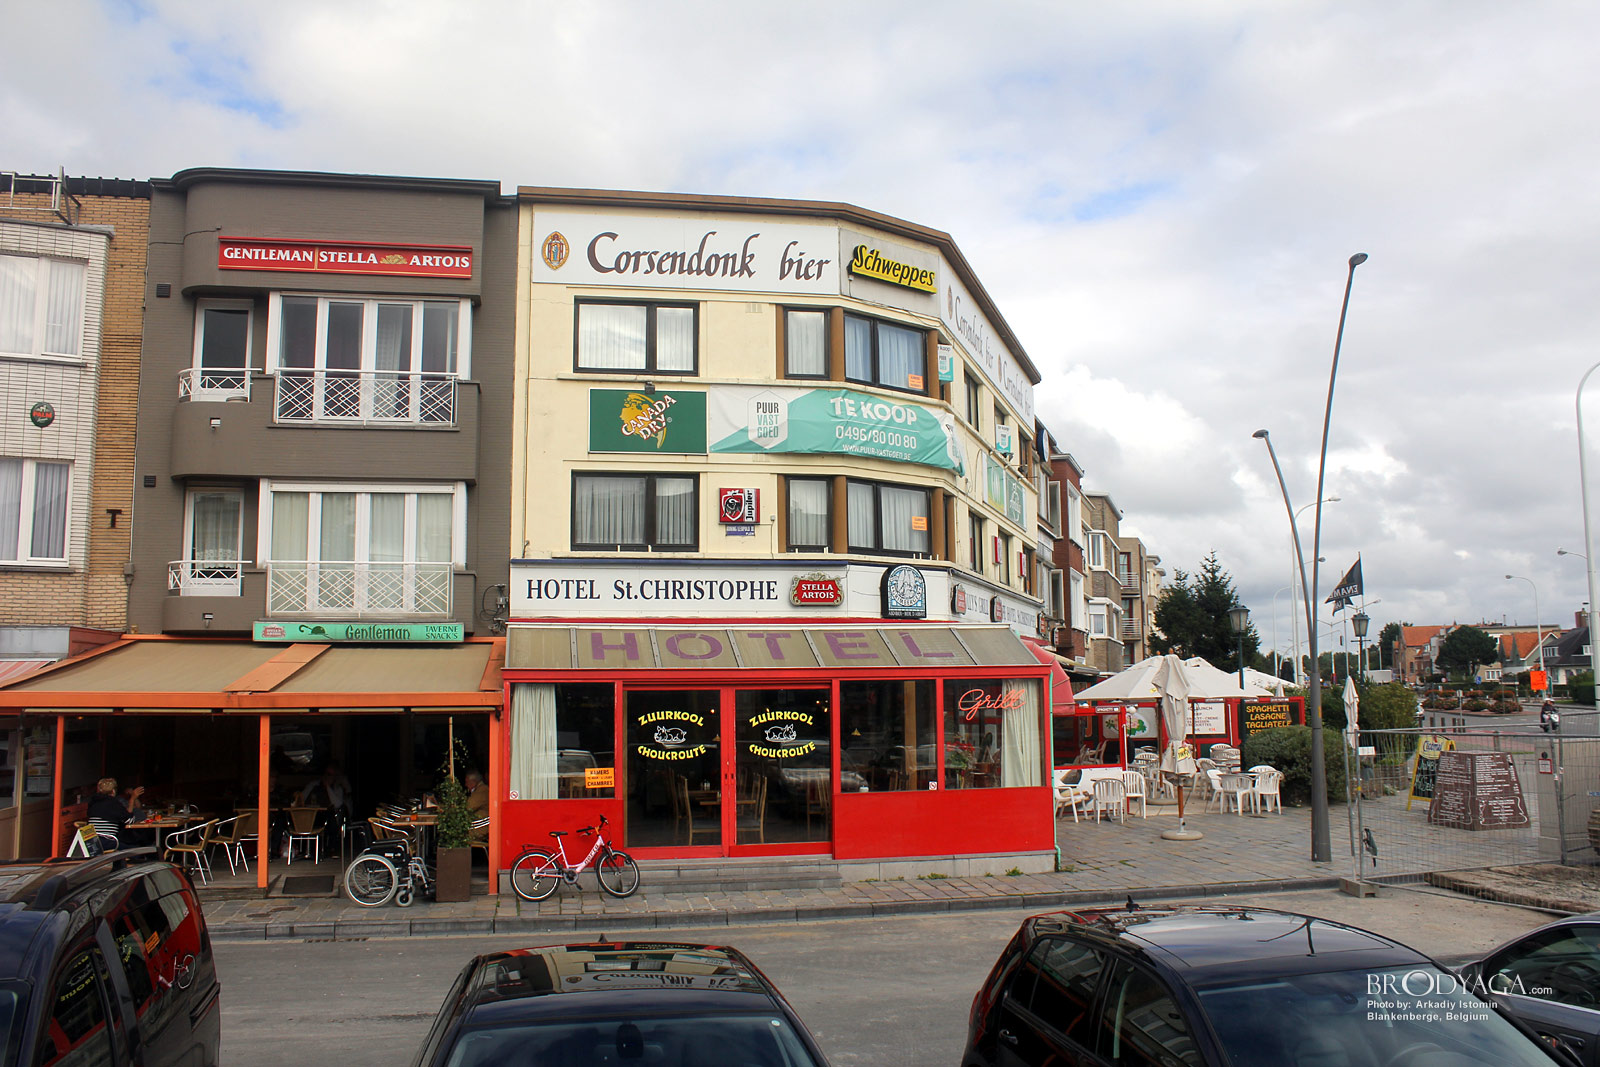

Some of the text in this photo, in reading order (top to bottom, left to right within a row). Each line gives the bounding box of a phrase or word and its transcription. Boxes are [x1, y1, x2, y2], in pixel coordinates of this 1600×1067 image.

[223, 247, 470, 268] GENTLEMAN STELLA ARTOIS
[587, 231, 831, 281] Corsendonk bier
[854, 244, 935, 286] Schweppes
[32, 411, 52, 419] PALM
[621, 394, 678, 436] CANADA
[756, 401, 779, 414] PUUR
[830, 396, 918, 426] TE KOOP
[639, 413, 666, 440] DRY
[756, 414, 779, 426] VAST
[756, 426, 779, 438] GOED
[835, 425, 917, 449] 0496/80 00 80
[746, 490, 755, 521] Jupiler
[526, 578, 779, 601] HOTEL St.CHRISTOPHE
[801, 583, 834, 591] STELLA
[801, 591, 835, 600] ARTOIS
[345, 624, 411, 641] Gentleman
[425, 625, 459, 633] TAVERNE
[590, 632, 955, 661] HOTEL
[958, 688, 1026, 721] Grill
[1246, 704, 1290, 713] SPAGHETTI
[638, 710, 704, 727] ZUURKOOL
[749, 710, 815, 728] ZUURKOOL
[1250, 712, 1287, 721] LASAGNE
[637, 744, 707, 761] CHOUCROUTE
[749, 741, 816, 758] CHOUCROUTE
